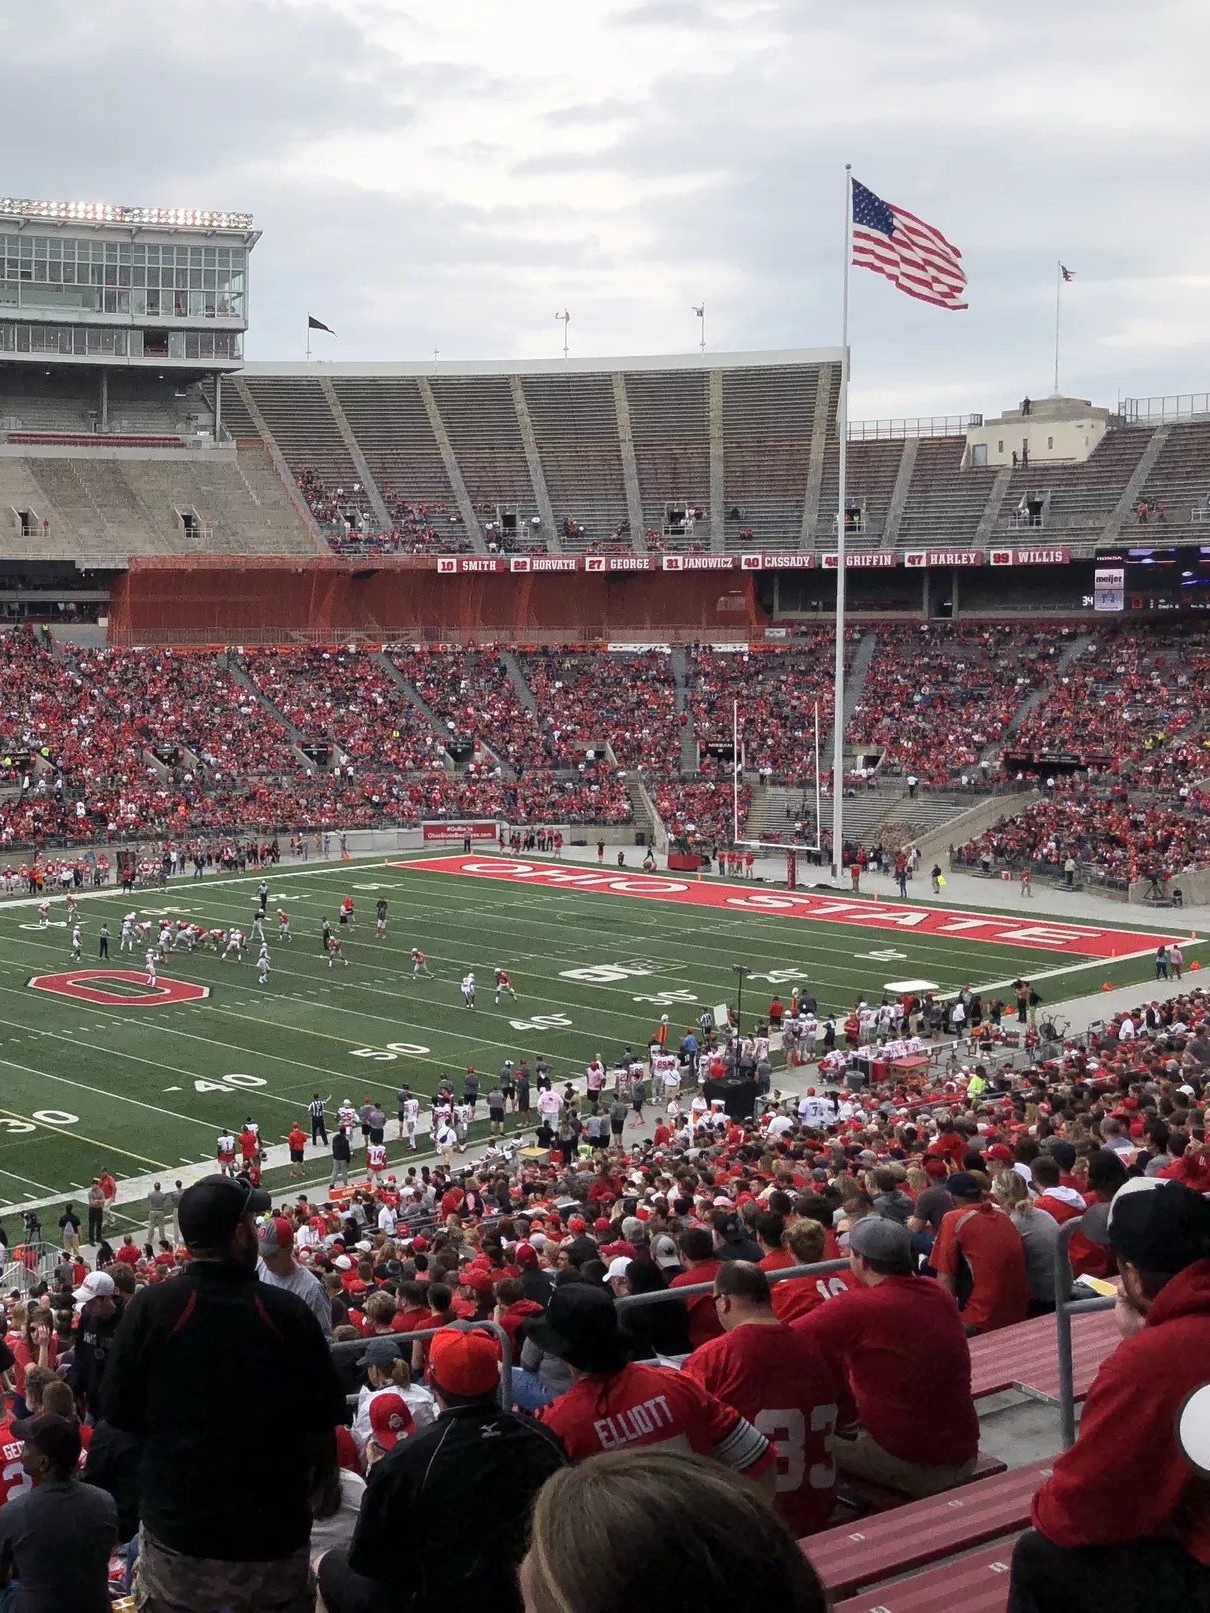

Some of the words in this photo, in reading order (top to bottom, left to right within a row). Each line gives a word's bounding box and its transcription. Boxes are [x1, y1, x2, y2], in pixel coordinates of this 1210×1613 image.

[666, 558, 680, 569] 31
[683, 557, 733, 569] JANOWICZ
[744, 556, 759, 568] 40
[764, 555, 811, 568] CASSADY
[846, 554, 892, 567] GRIFFIN
[907, 554, 925, 566] 47
[930, 553, 977, 565] HARLEY
[992, 551, 1009, 563] 99
[1018, 550, 1063, 563] WILLIS
[441, 561, 454, 571] 10
[462, 560, 496, 571] SMITH
[513, 561, 527, 570] 22
[532, 559, 576, 570] HORVATH
[588, 559, 603, 570] 27
[610, 558, 649, 569] GEORGE
[1095, 574, 1122, 584] meijer
[1082, 596, 1094, 606] 34
[460, 863, 689, 893] OHIO
[725, 894, 1103, 945] STATE
[854, 949, 908, 962] 10
[746, 969, 809, 984] 20
[632, 991, 698, 1006] 30
[508, 1014, 573, 1032] 40
[349, 1042, 431, 1061] 50
[194, 1073, 268, 1094] 40
[341, 1112, 352, 1121] 25
[738, 1130, 745, 1143] 7
[226, 1141, 230, 1149] 1
[373, 1151, 383, 1161] 14
[593, 1395, 674, 1449] ELLIOTT
